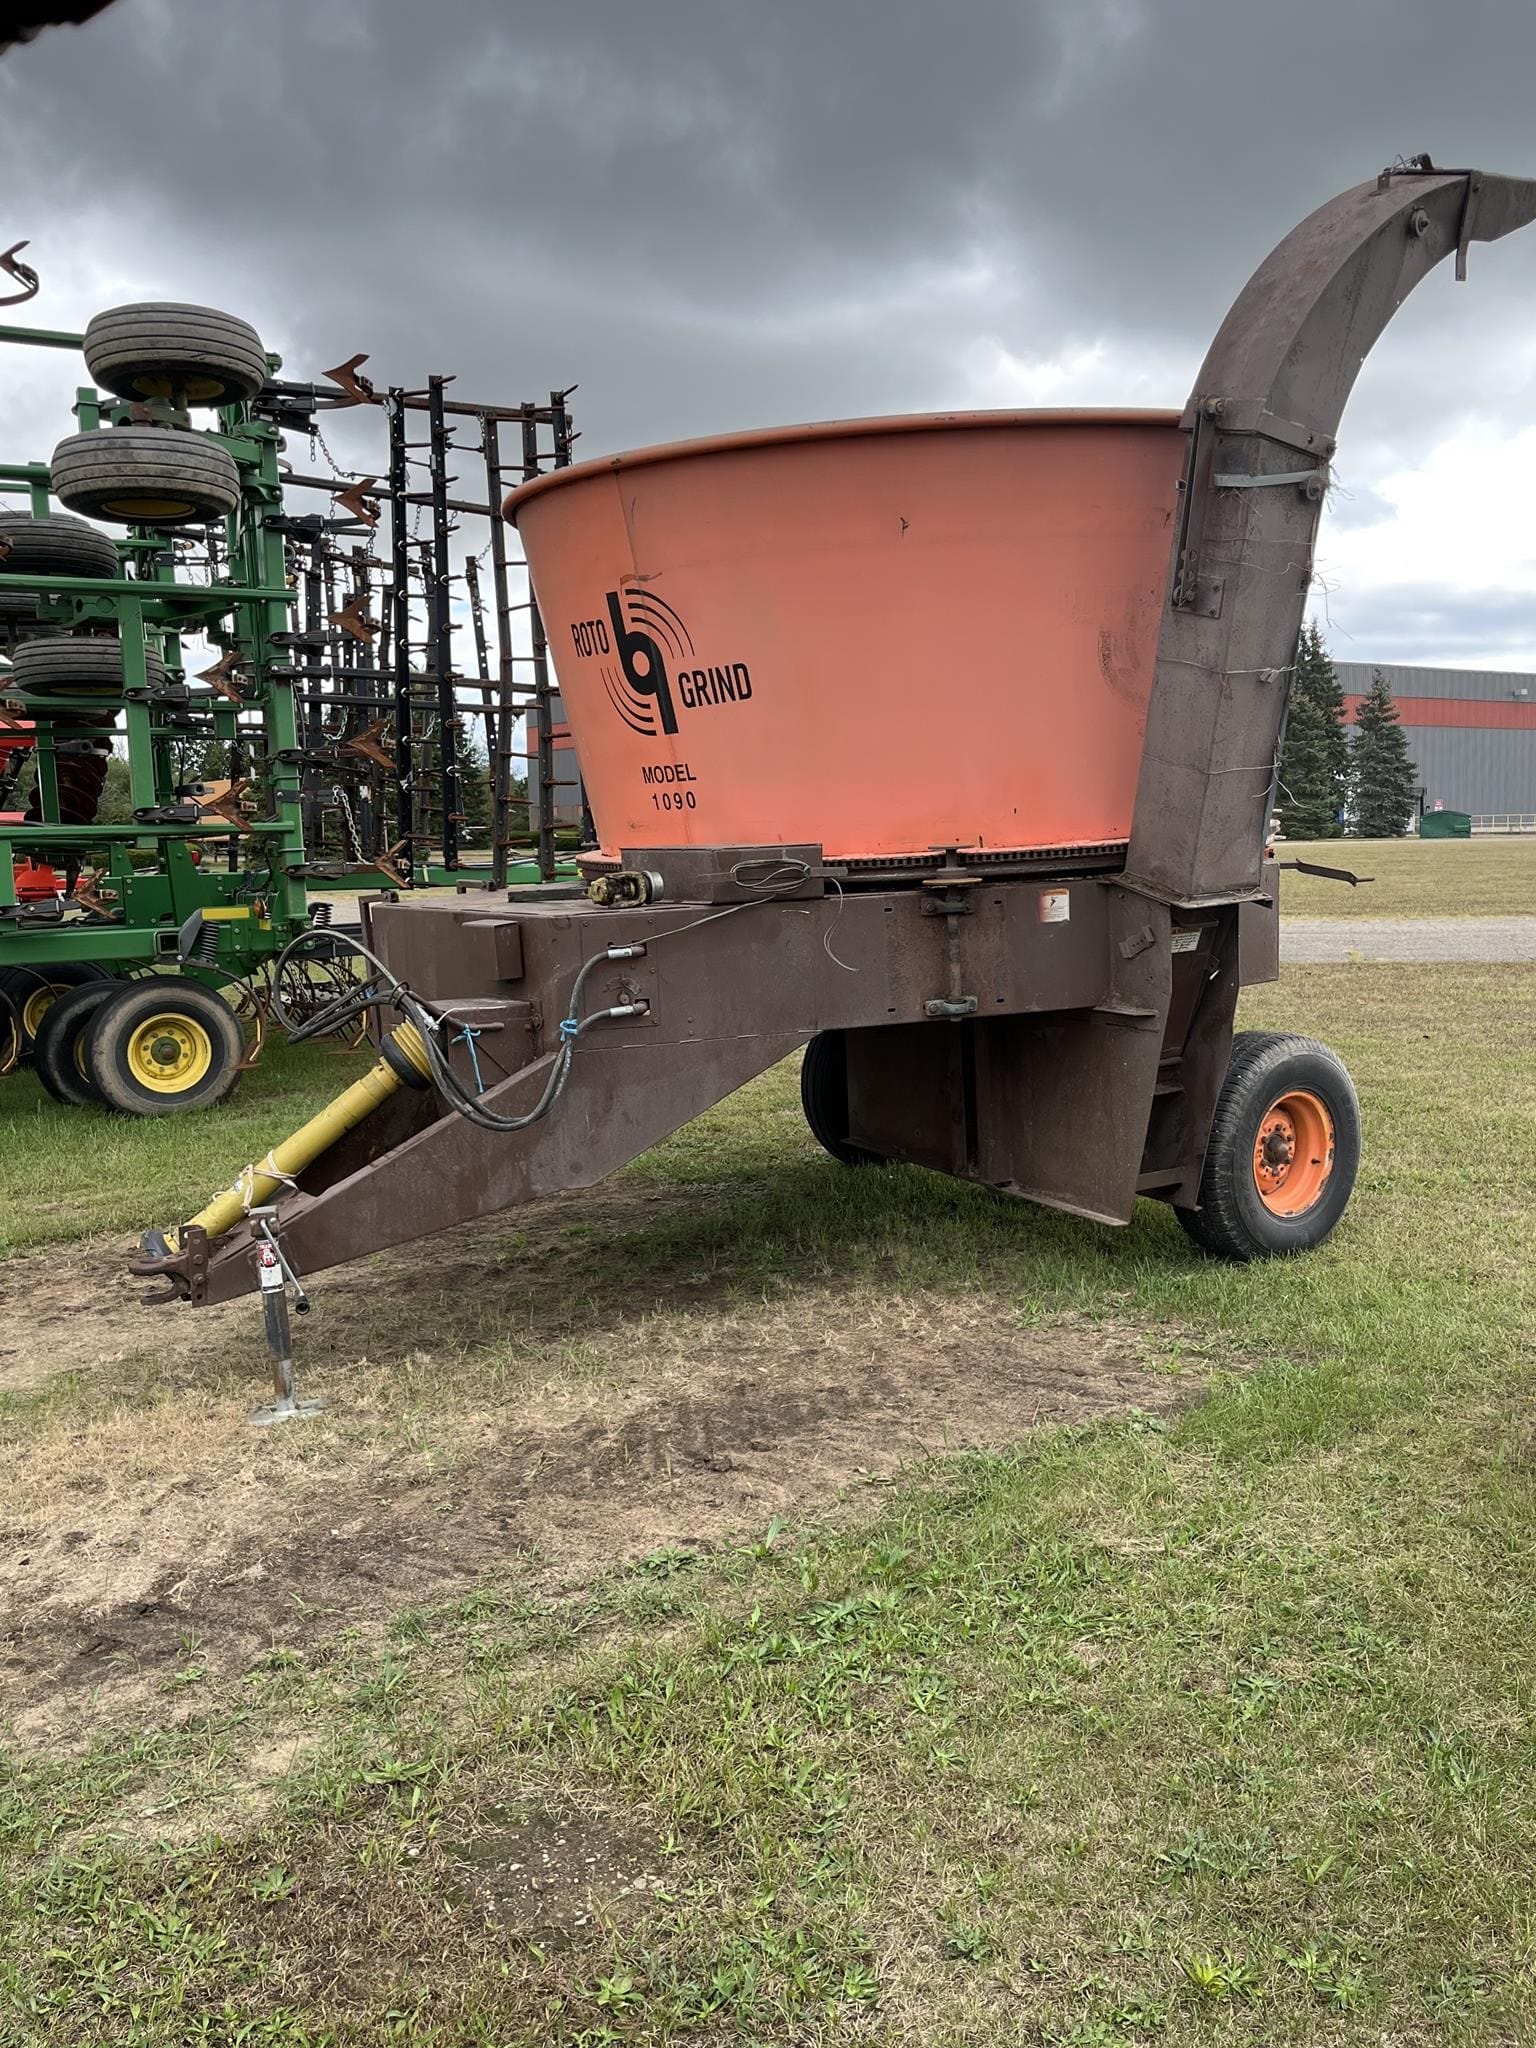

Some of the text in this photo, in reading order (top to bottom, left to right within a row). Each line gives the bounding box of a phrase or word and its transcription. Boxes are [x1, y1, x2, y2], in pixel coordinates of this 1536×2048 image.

[571, 619, 609, 657] ROTO
[678, 663, 752, 708] GRIND
[642, 763, 696, 784] MODEL
[652, 791, 696, 811] 1090
